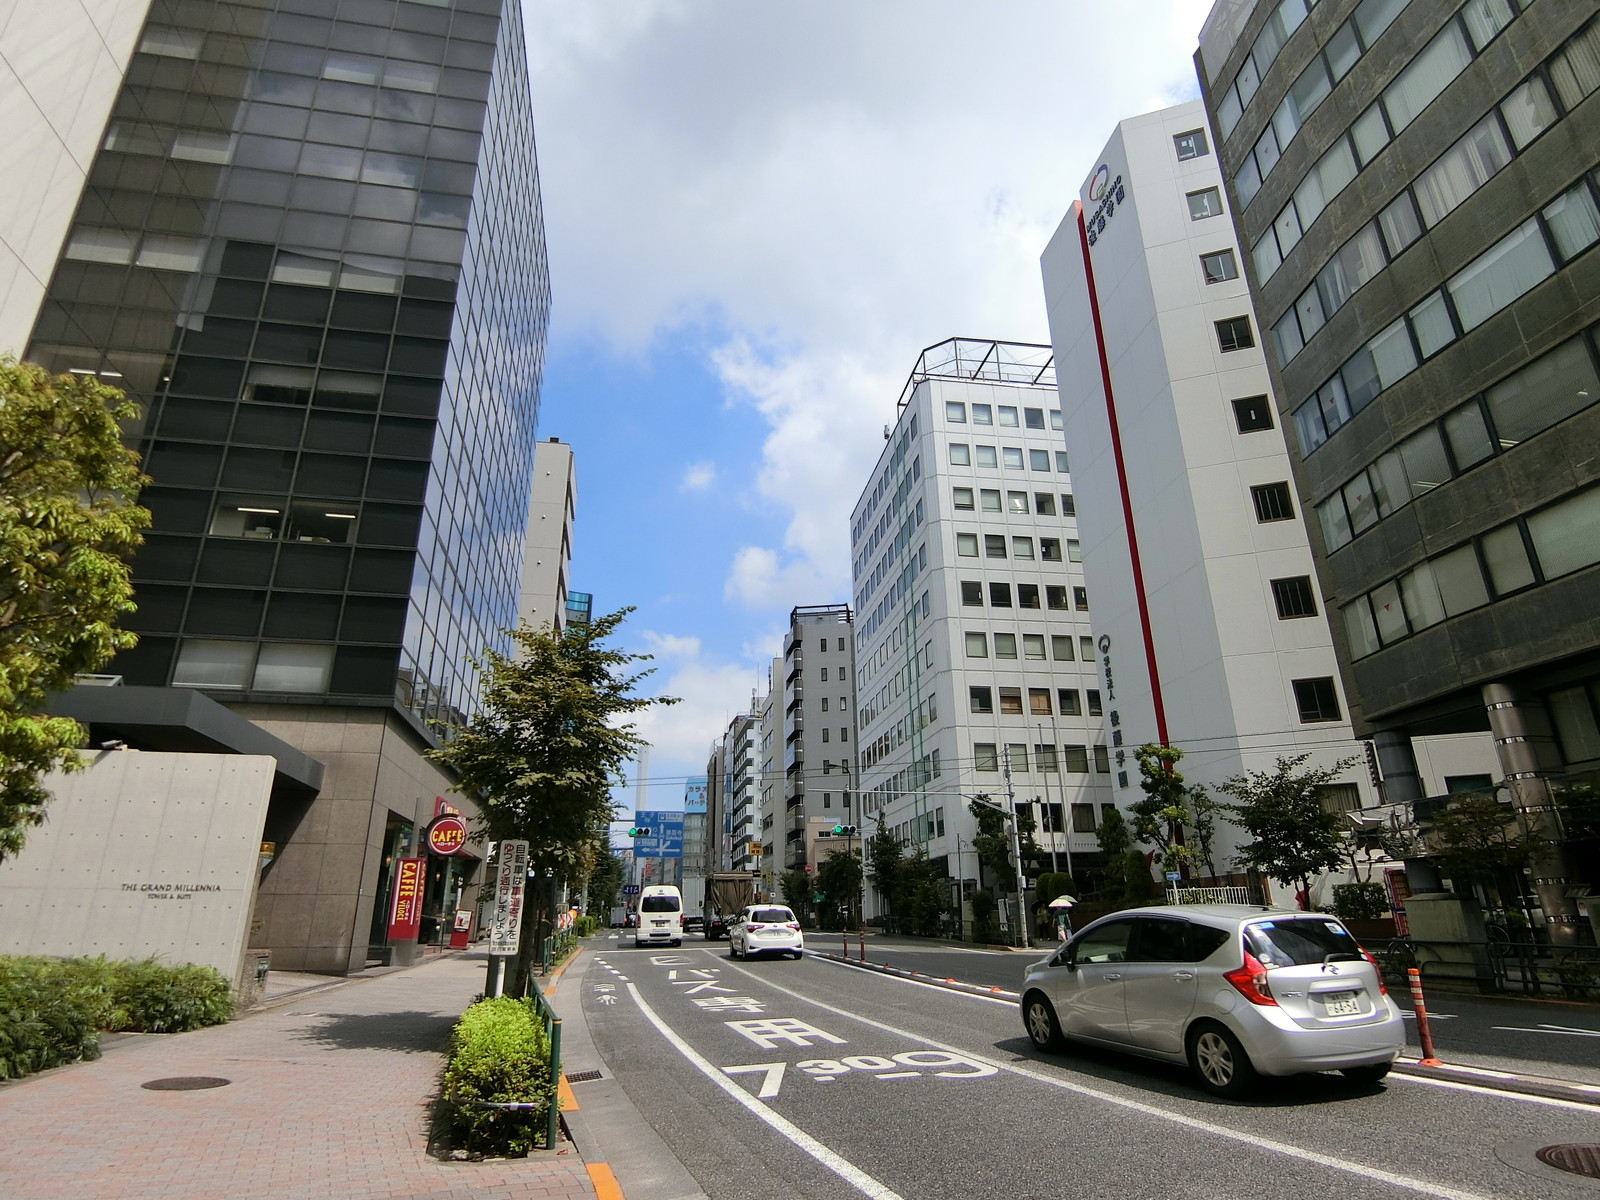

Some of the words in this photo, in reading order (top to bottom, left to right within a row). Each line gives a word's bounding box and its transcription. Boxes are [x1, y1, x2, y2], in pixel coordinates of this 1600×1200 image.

[121, 883, 138, 891] THE
[174, 884, 221, 892] MILLENNIA
[493, 844, 514, 939] ゆっくり通行しましょう
[507, 844, 525, 939] 自転車は車道寄りを
